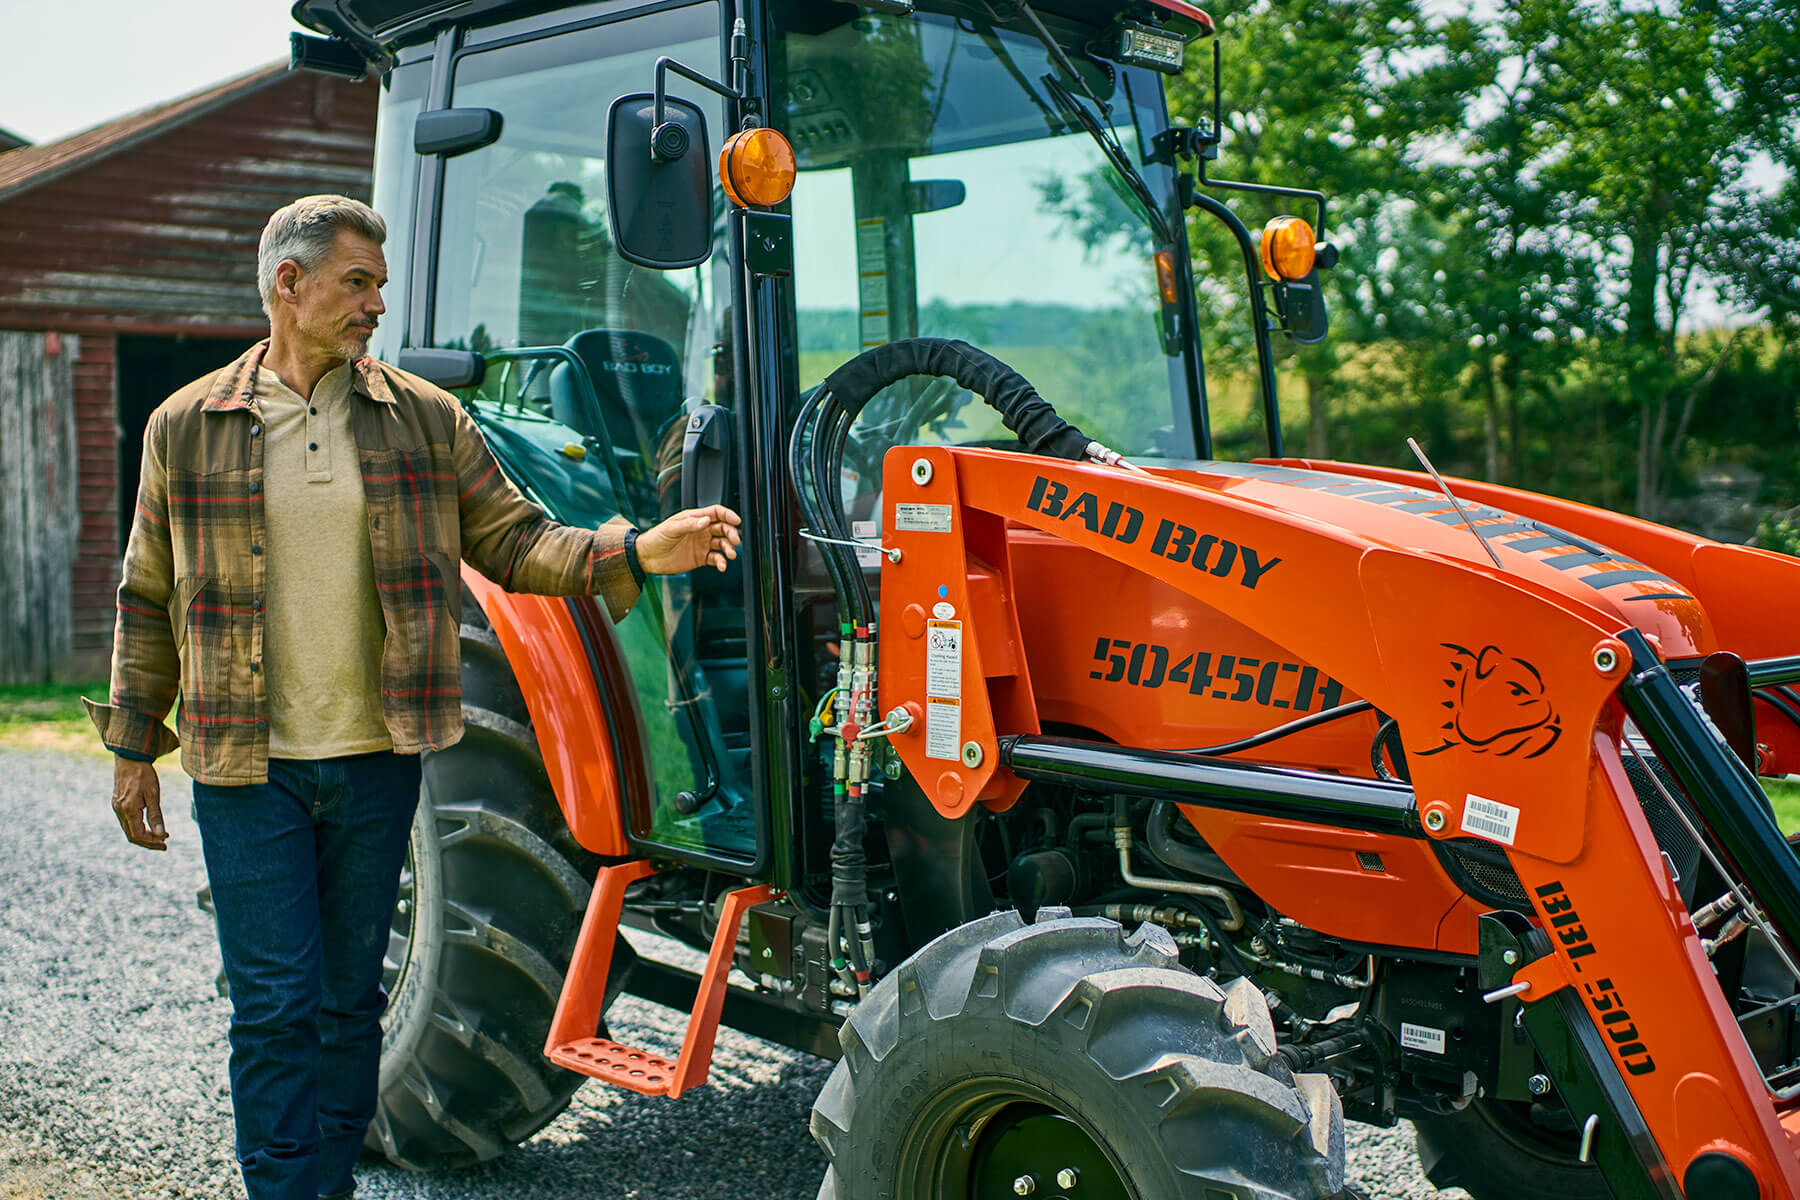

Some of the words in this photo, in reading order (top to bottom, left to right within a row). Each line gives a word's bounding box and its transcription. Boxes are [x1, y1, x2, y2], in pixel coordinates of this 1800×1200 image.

[603, 361, 638, 374] BAD
[640, 363, 672, 375] BOY
[1026, 475, 1144, 545] BAD
[1150, 518, 1283, 590] BOY
